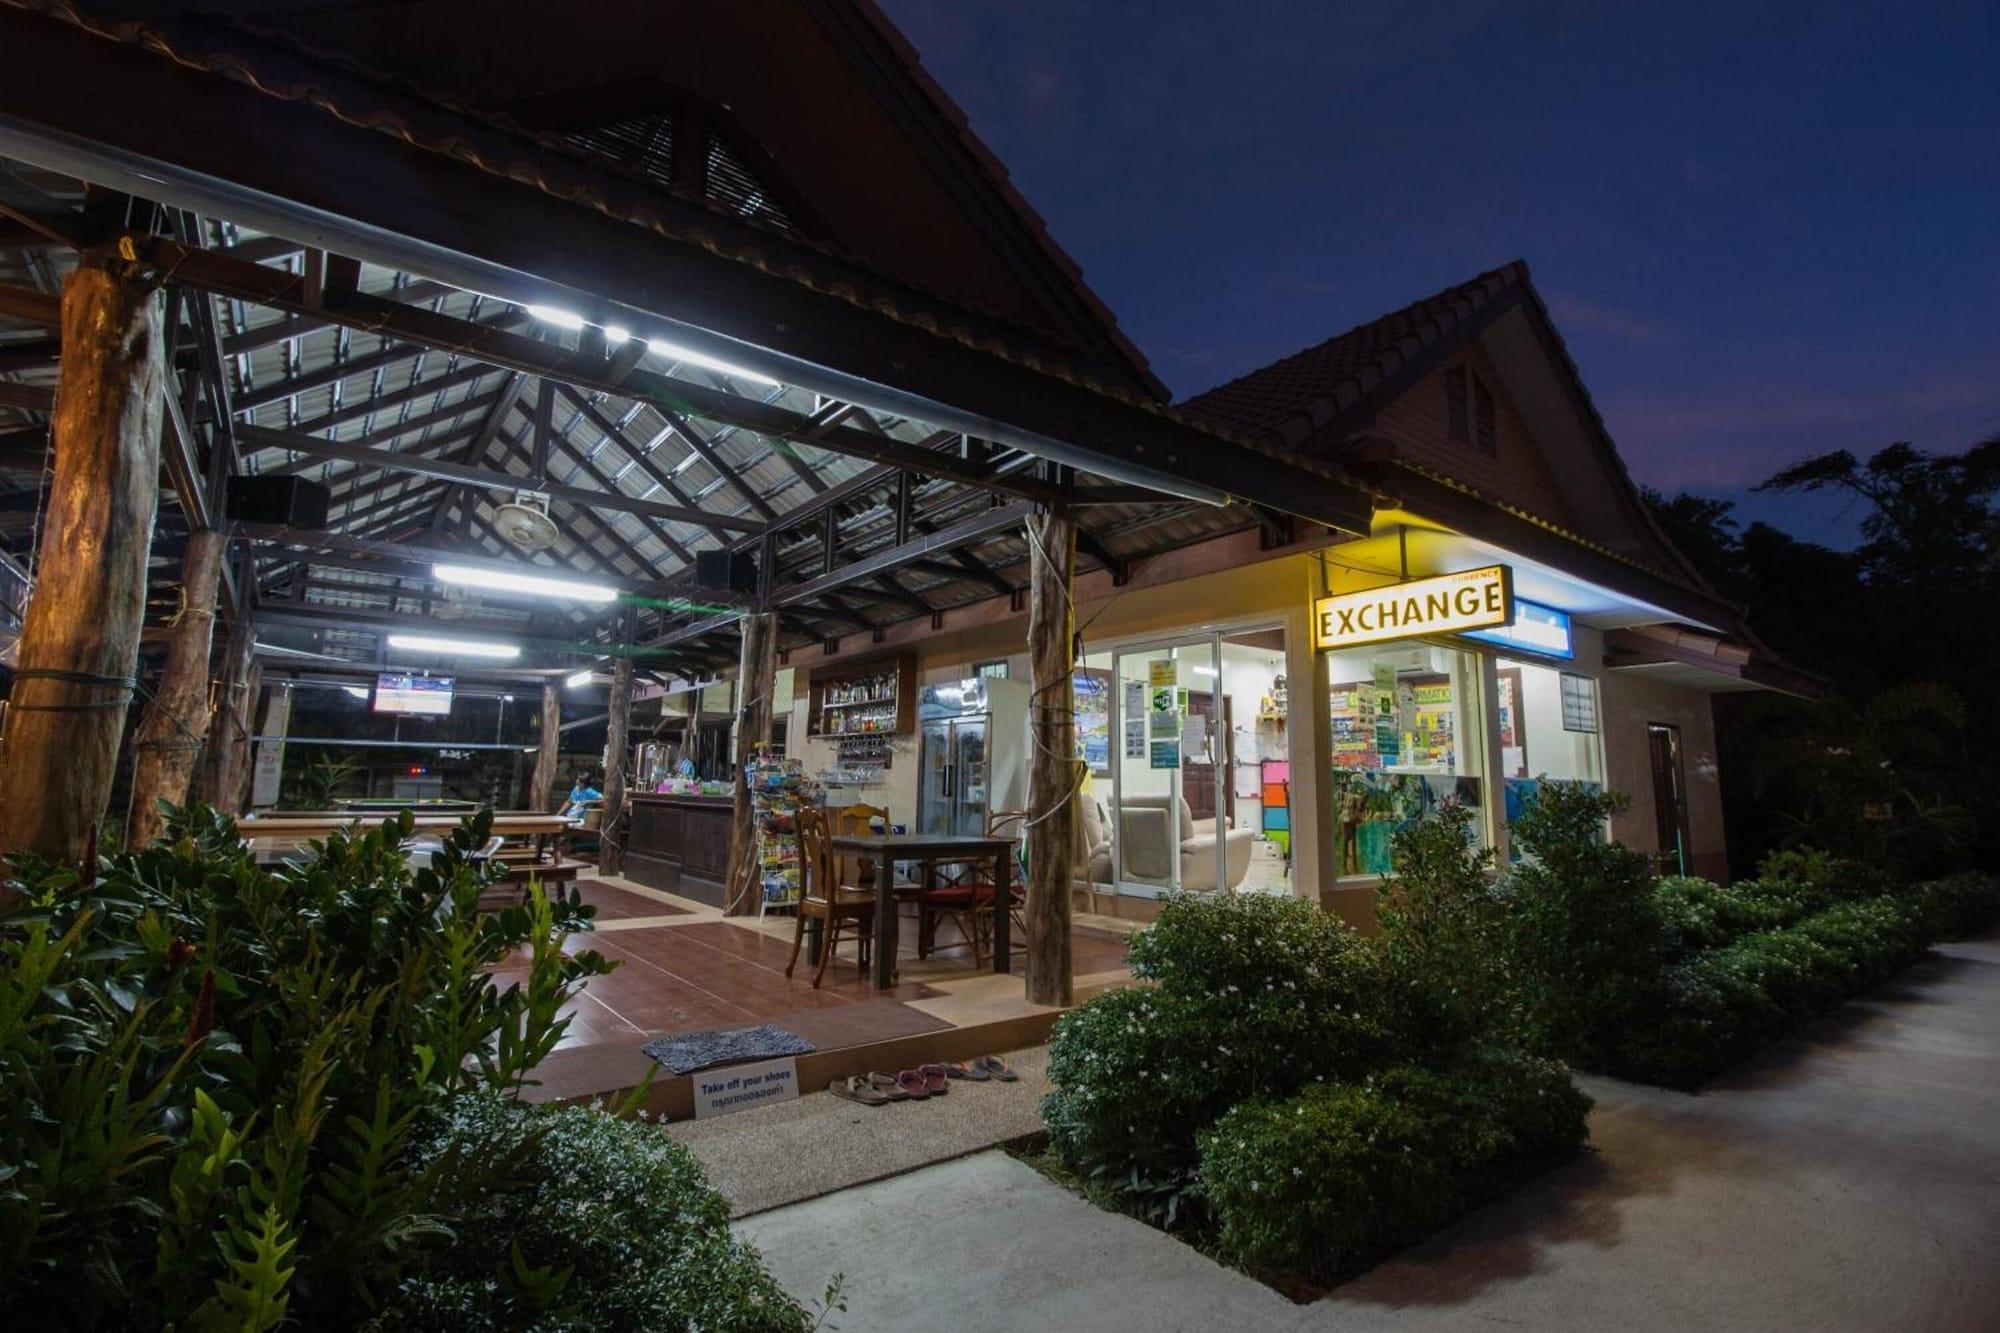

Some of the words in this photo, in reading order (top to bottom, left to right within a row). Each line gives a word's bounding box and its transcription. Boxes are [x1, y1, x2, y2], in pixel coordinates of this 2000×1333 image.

[1320, 584, 1501, 638] EXCHANGE
[702, 1083, 725, 1095] Take
[727, 1077, 740, 1090] off
[743, 1075, 763, 1089] your
[764, 1070, 791, 1083] shoes
